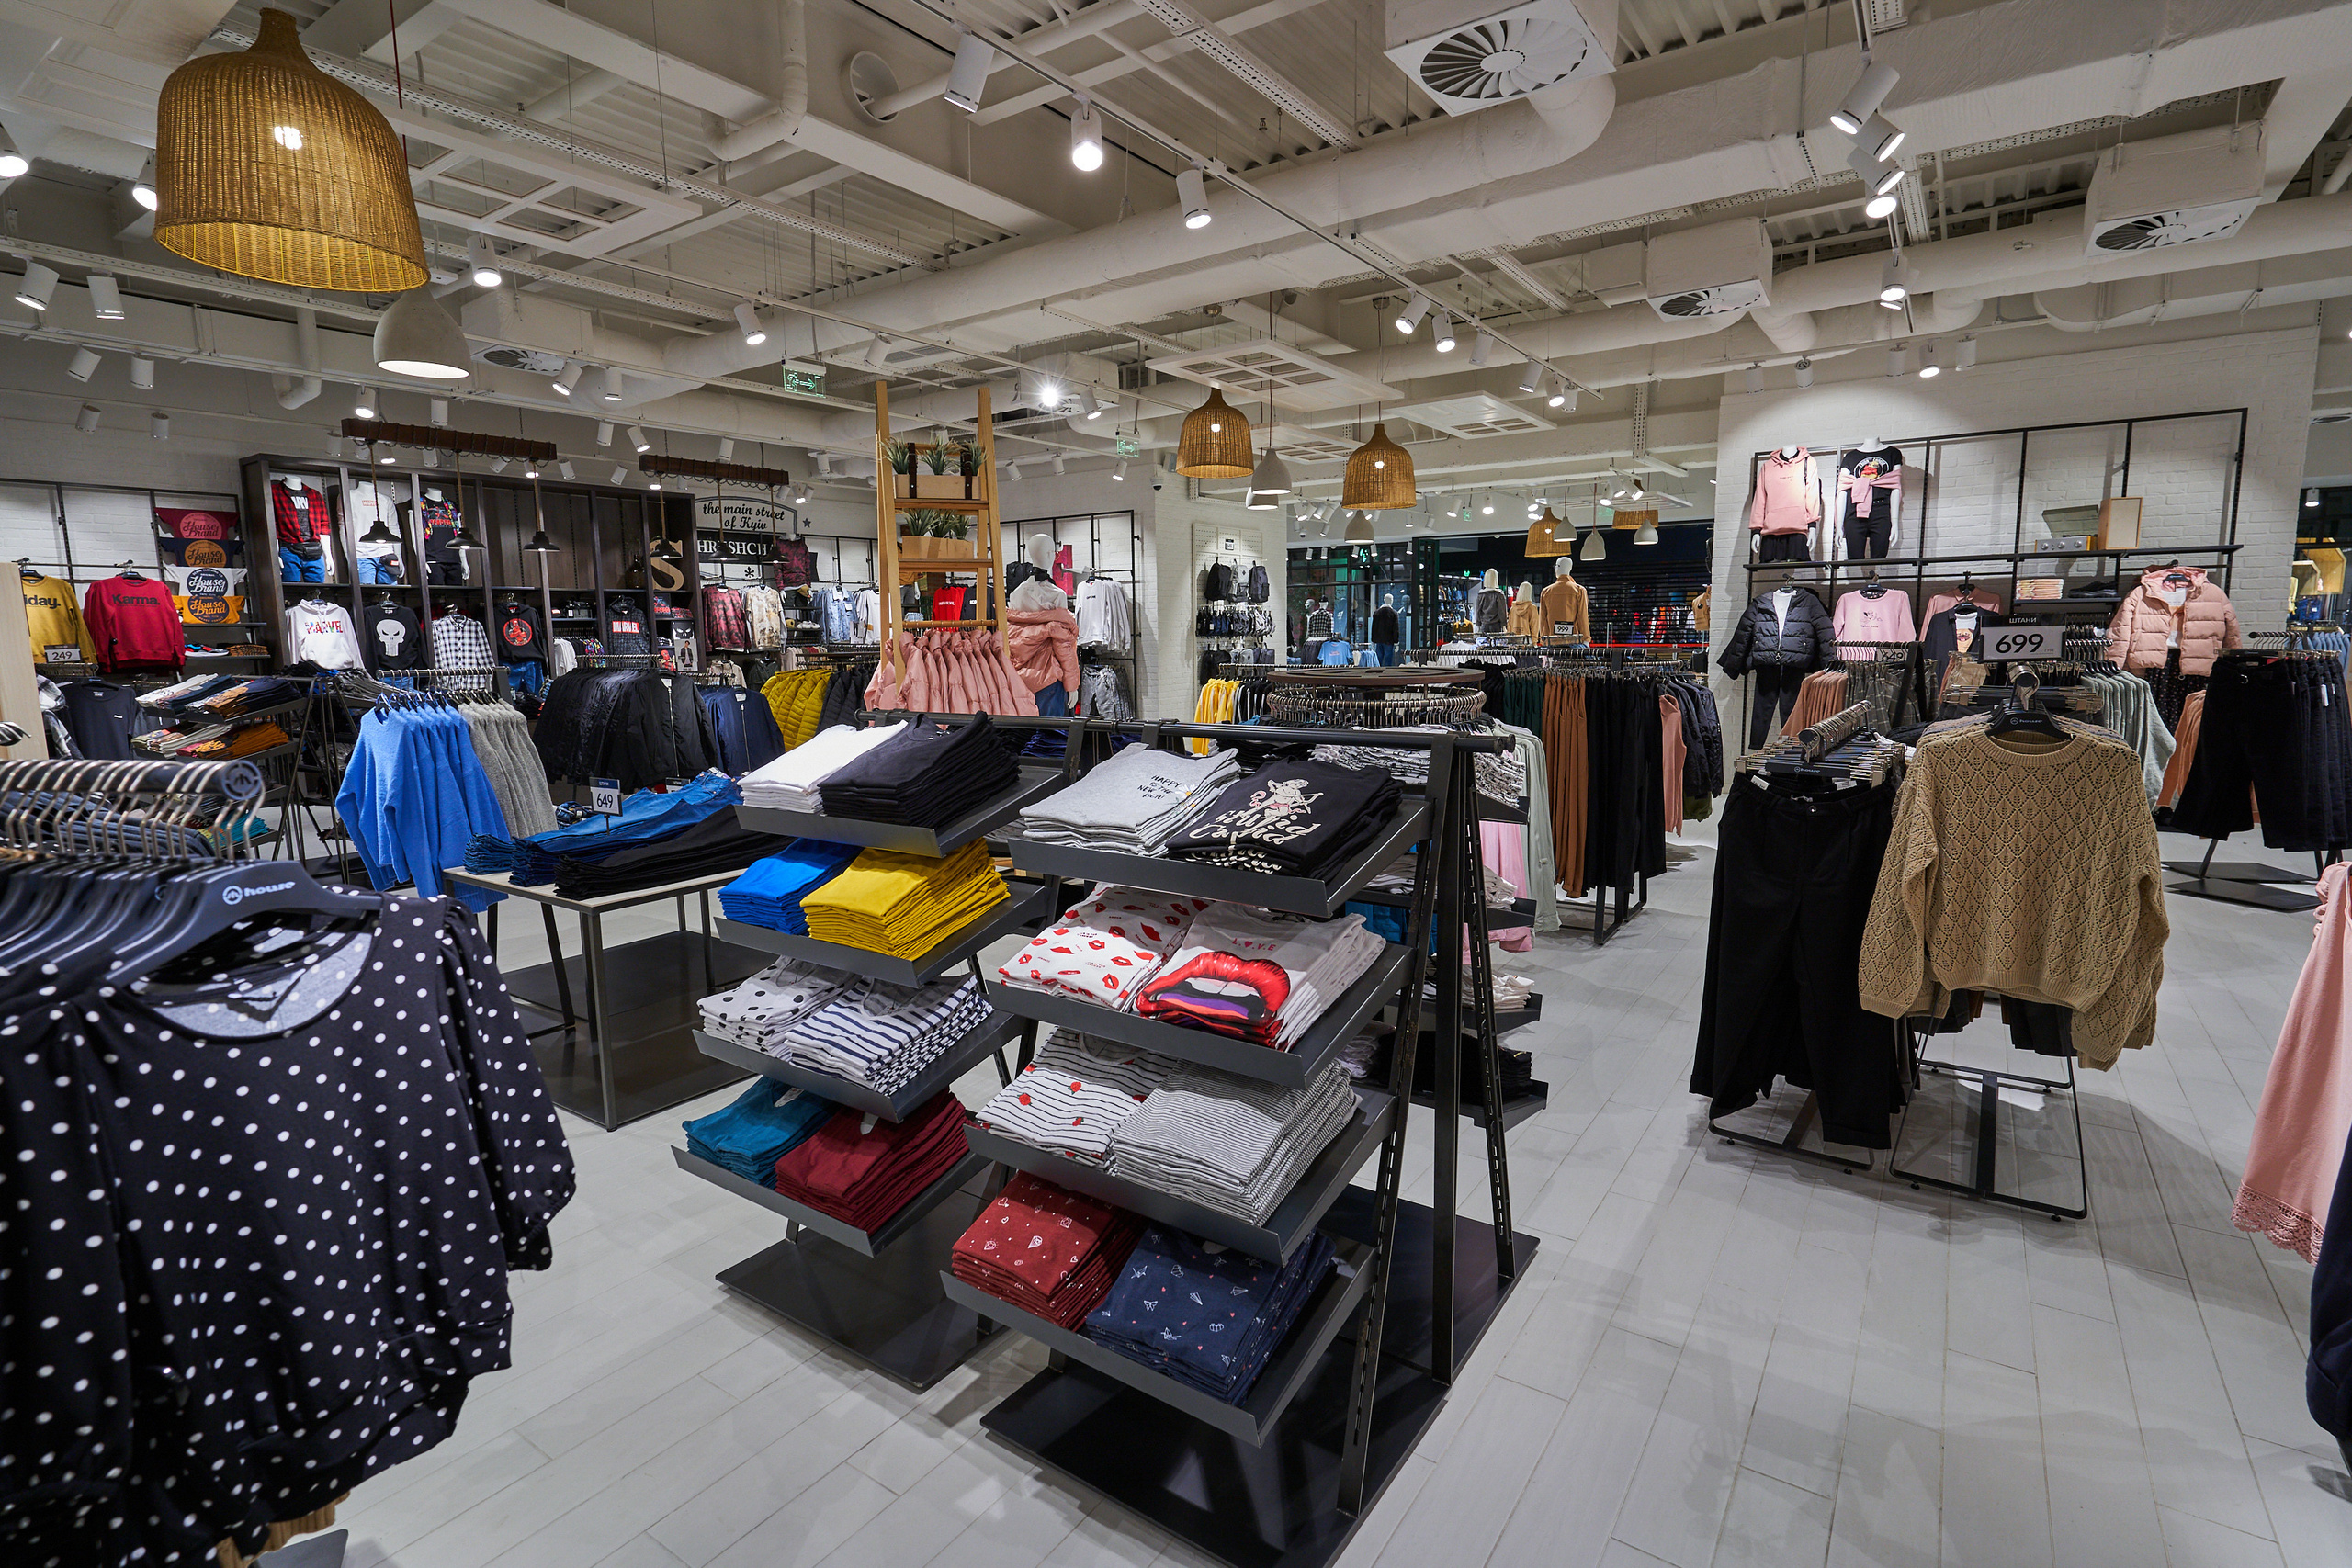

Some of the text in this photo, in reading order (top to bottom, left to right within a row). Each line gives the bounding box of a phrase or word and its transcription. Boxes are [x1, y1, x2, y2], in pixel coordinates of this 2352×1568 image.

[703, 502, 720, 514] the
[723, 502, 752, 515] main
[184, 521, 218, 534] House
[724, 516, 767, 531] of Kyiv
[186, 525, 220, 538] Brand
[187, 548, 220, 561] House
[189, 553, 224, 567] Brand
[188, 575, 225, 587] House
[190, 581, 226, 593] Brand
[24, 595, 62, 609] iday.
[112, 593, 161, 605] Karma.
[189, 599, 223, 611] House
[193, 603, 227, 615] Brand
[1995, 633, 2044, 654] 699
[51, 650, 73, 660] 249
[1150, 774, 1182, 788] HAPPY
[596, 793, 614, 809] 649
[243, 881, 296, 897] house
